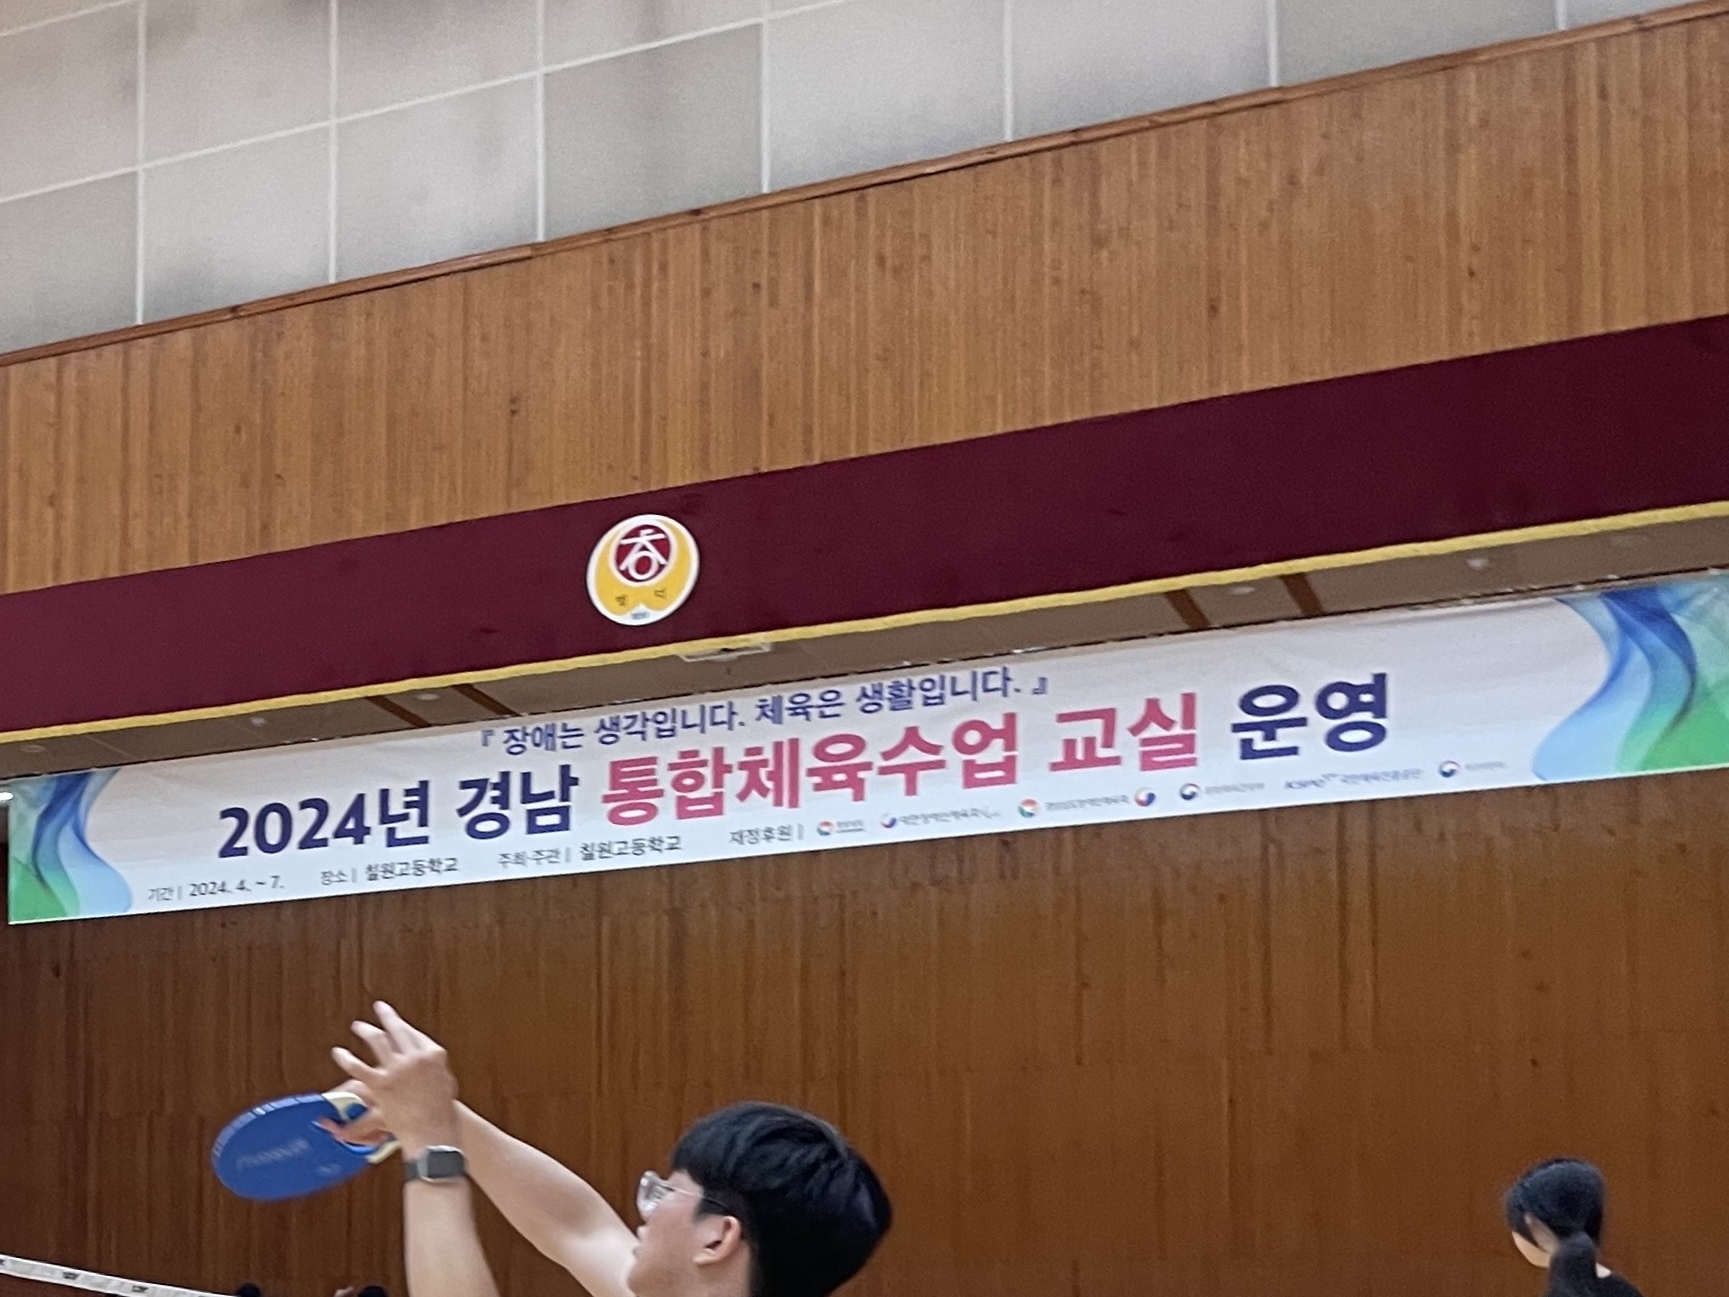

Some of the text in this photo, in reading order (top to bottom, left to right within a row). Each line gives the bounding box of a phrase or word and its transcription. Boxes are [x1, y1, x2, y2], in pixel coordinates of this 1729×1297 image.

[219, 672, 1388, 859] 2024년 경남 통합체육수업 교실 운영
[503, 722, 586, 756] 장애는
[594, 700, 746, 746] 생각입니다.
[754, 688, 847, 725] 체육은
[855, 666, 1022, 714] 생활입니다.
